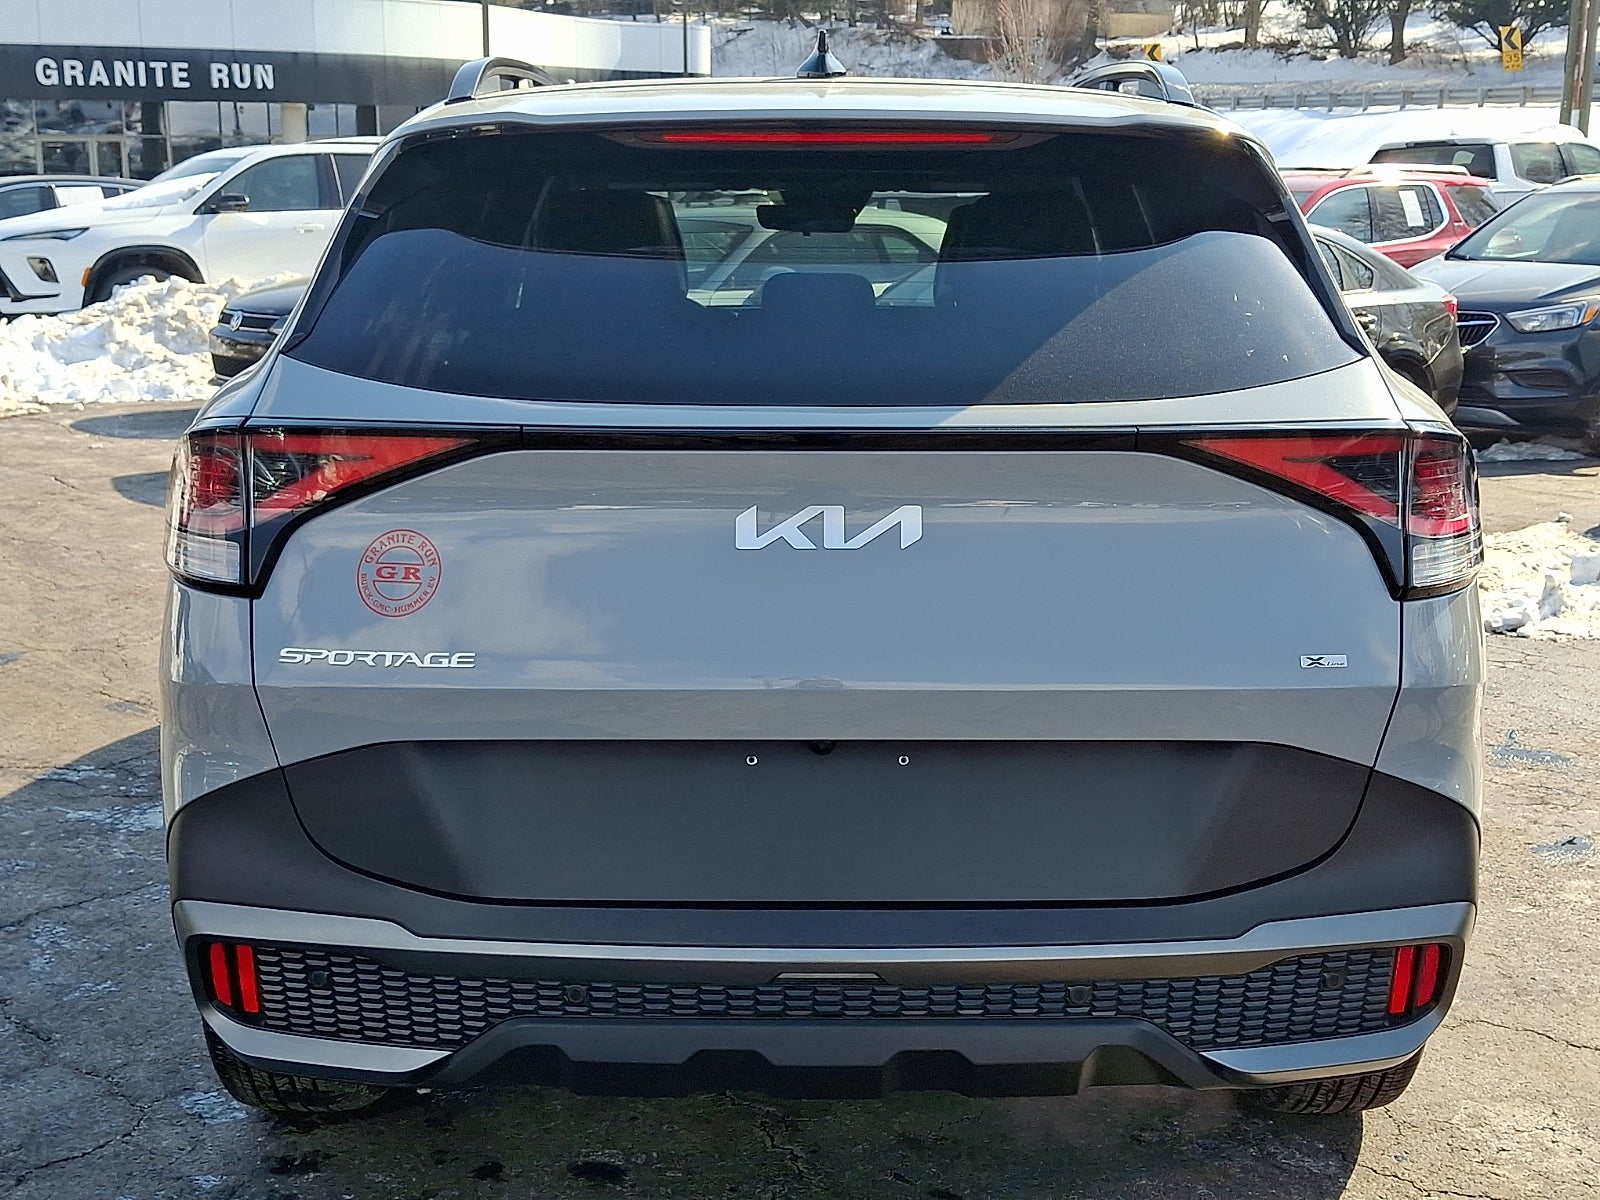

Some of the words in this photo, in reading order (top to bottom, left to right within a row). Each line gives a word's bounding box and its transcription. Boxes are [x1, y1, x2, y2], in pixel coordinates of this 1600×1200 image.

[35, 57, 191, 88] GRANITE
[210, 62, 275, 90] RUN
[735, 504, 922, 550] KIA
[364, 533, 416, 564] GRANITE
[418, 541, 438, 567] RUN
[375, 566, 421, 580] GR
[278, 647, 476, 668] SPORTAGE
